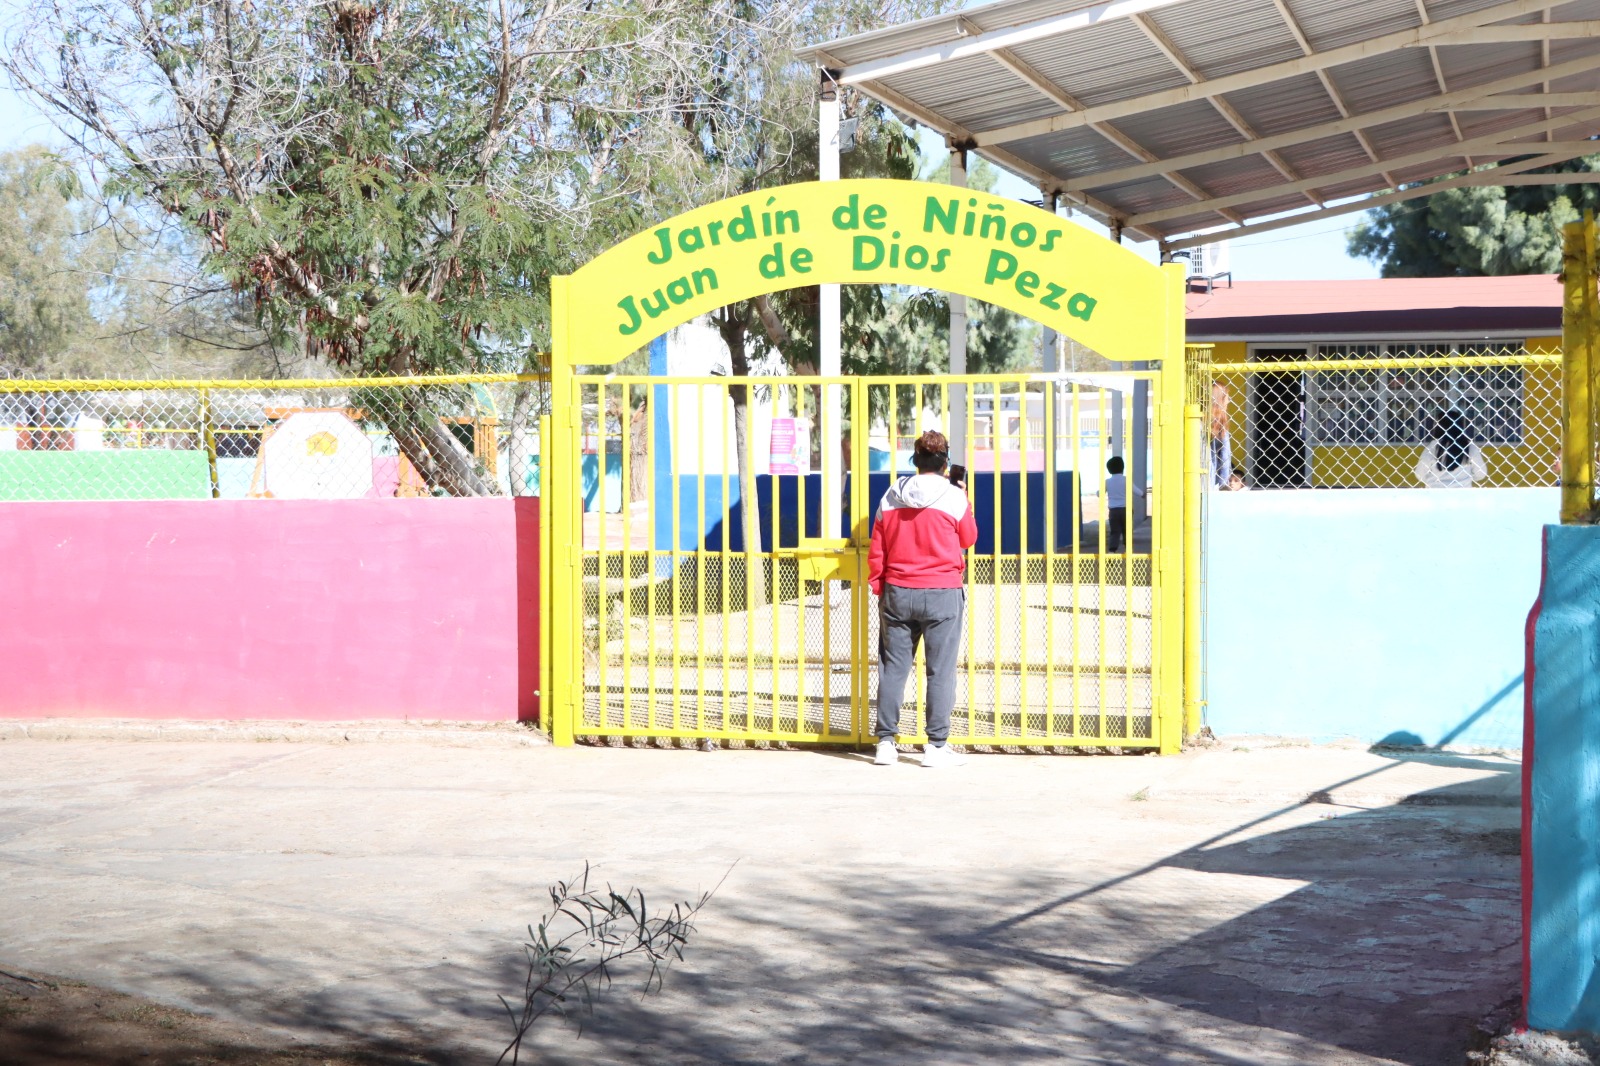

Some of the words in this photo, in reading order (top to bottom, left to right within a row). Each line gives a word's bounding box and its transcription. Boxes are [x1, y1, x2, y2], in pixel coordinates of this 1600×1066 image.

[647, 196, 800, 265] Jardín
[832, 193, 887, 230] de
[923, 196, 1063, 252] Niños
[617, 267, 719, 336] Juan
[759, 242, 813, 280] de
[852, 231, 951, 273] Dios
[984, 248, 1098, 322] Peza
